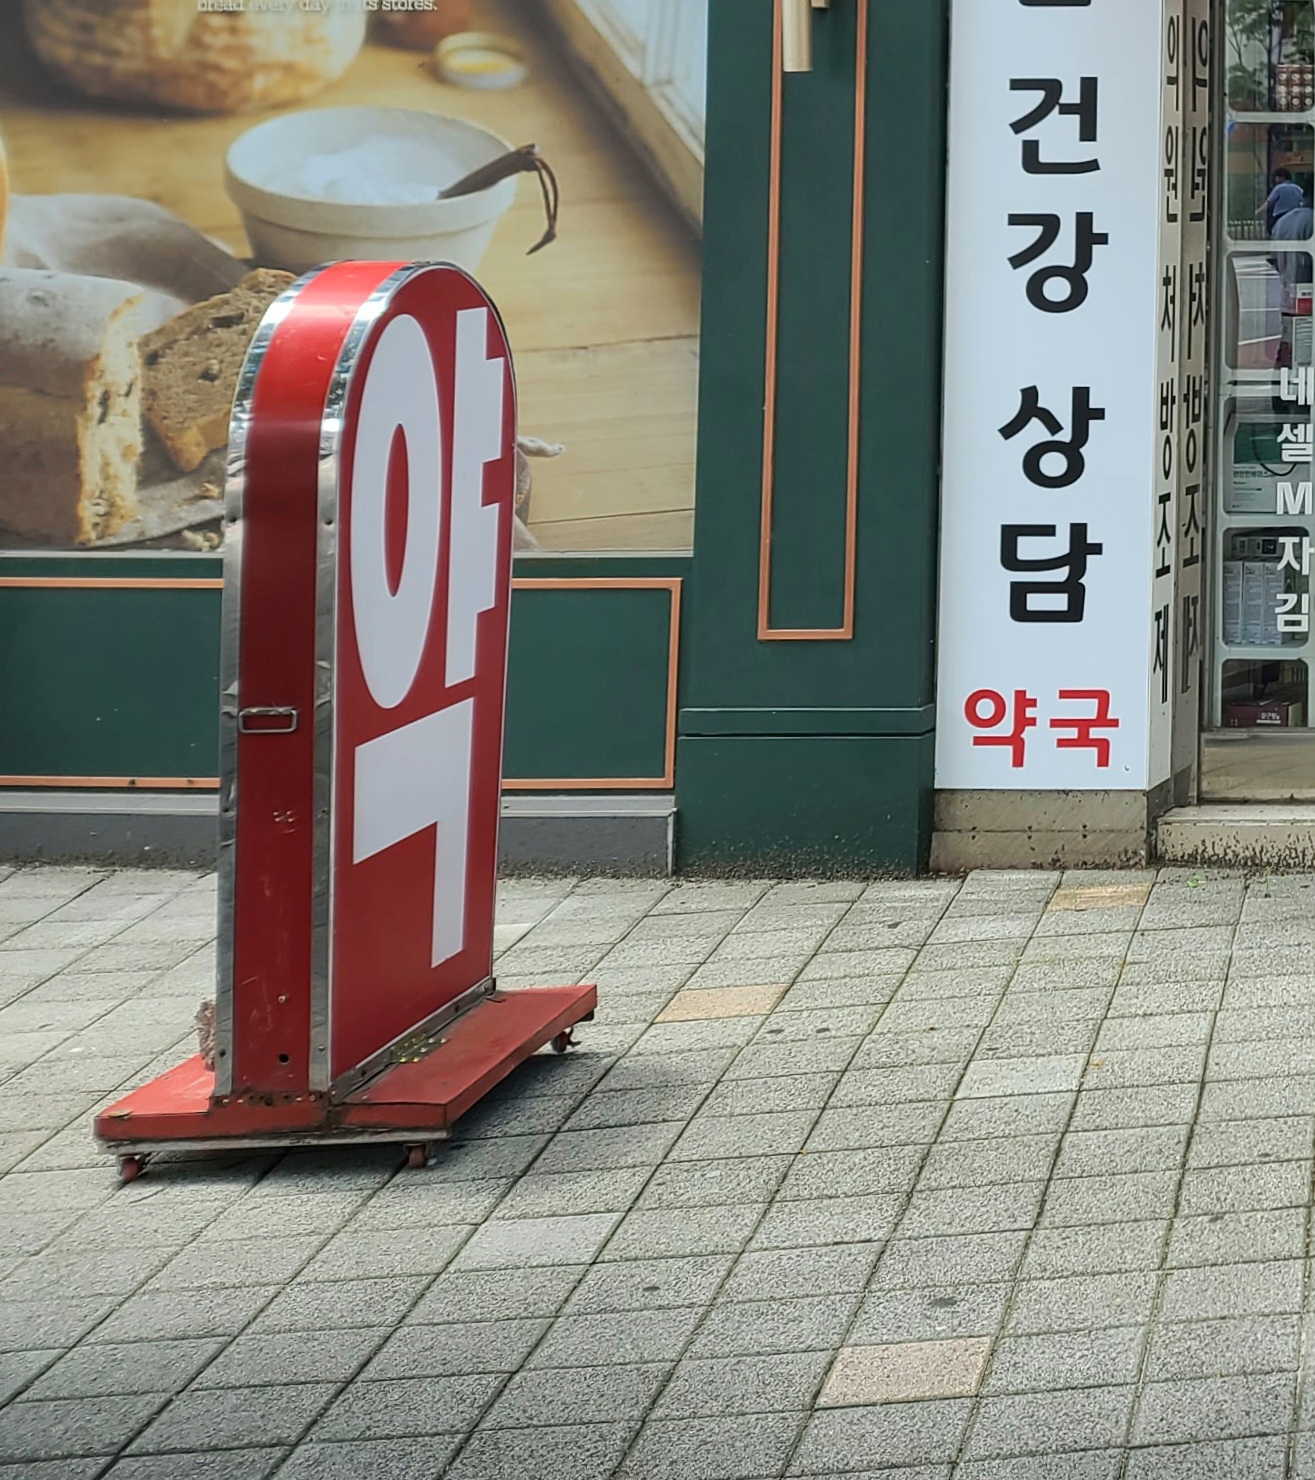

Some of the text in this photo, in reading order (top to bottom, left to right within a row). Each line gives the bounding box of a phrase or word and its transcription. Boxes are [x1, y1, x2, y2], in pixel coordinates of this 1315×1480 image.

[249, 0, 299, 14] every
[1006, 76, 1109, 314] 건강
[997, 385, 1106, 624] 상담
[351, 307, 506, 969] 약
[963, 688, 1120, 769] 약국
